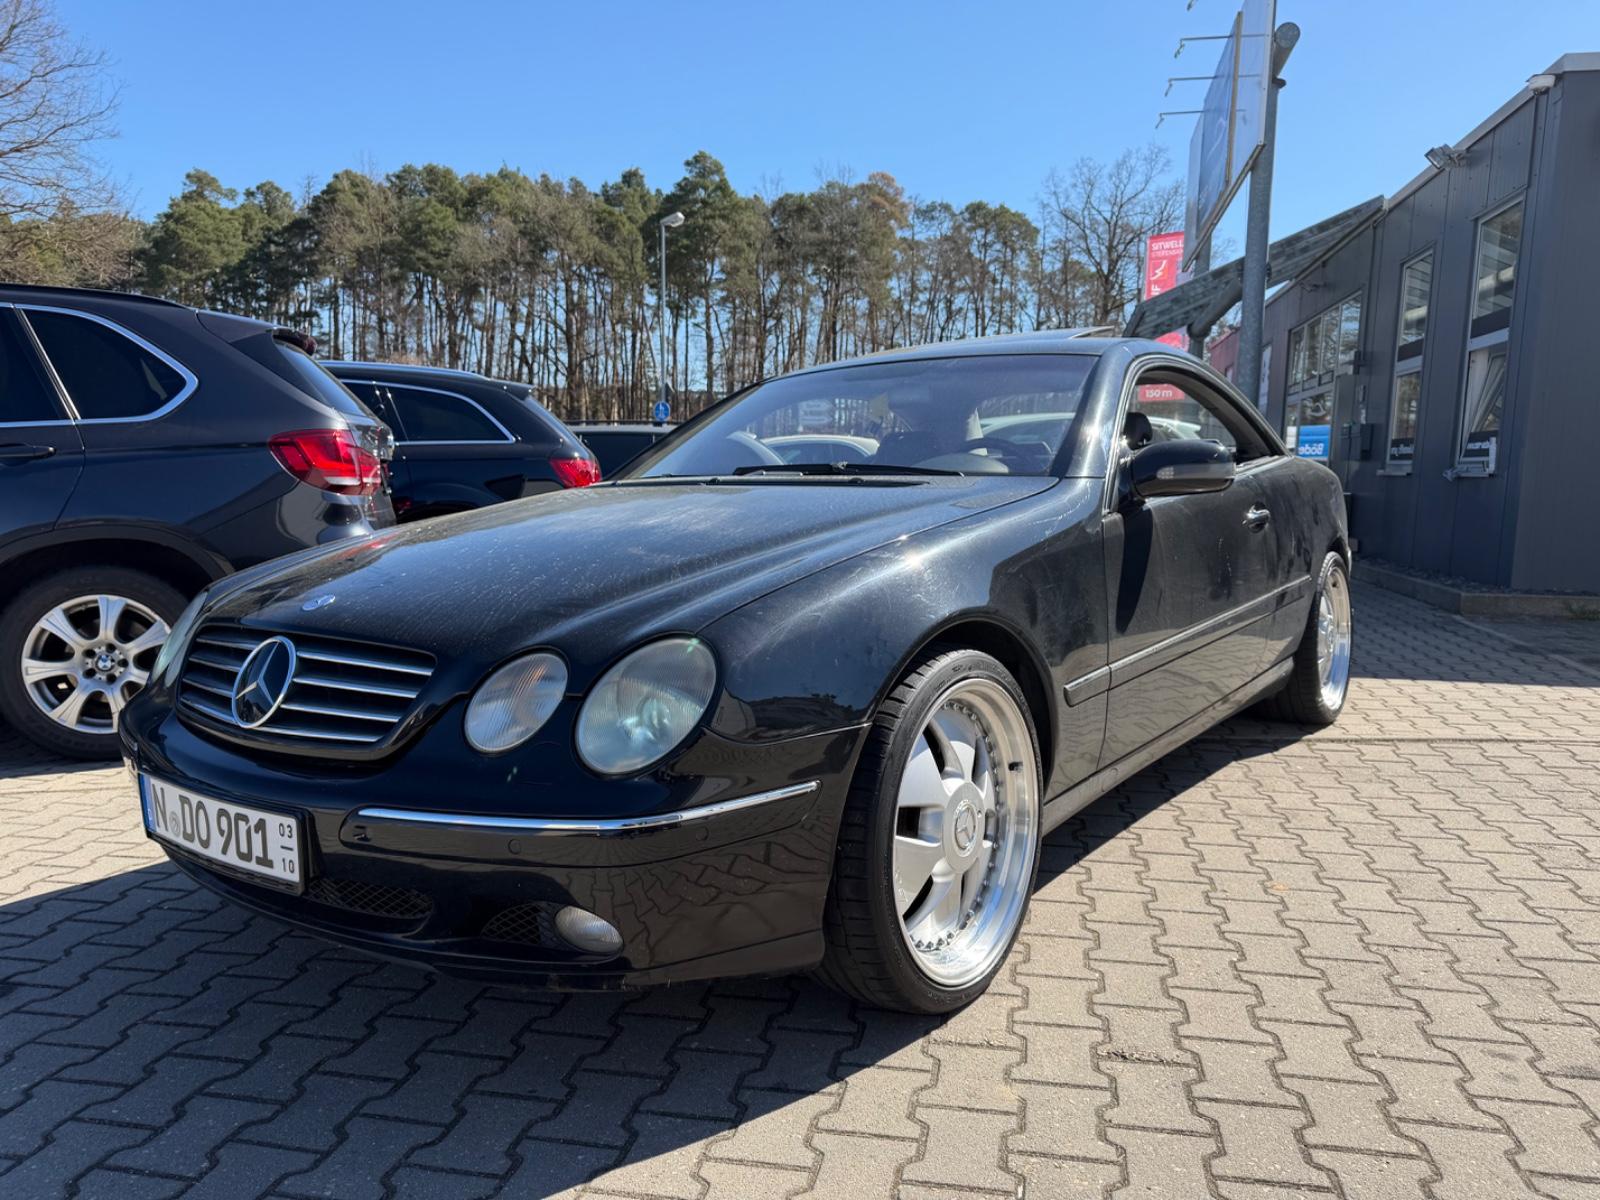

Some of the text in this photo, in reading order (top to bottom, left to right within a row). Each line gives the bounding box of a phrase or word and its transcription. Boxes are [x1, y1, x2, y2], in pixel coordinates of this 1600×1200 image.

[1145, 389, 1173, 398] 150 m
[152, 783, 274, 869] N DO 901
[278, 822, 293, 839] 03
[281, 857, 295, 874] 10
